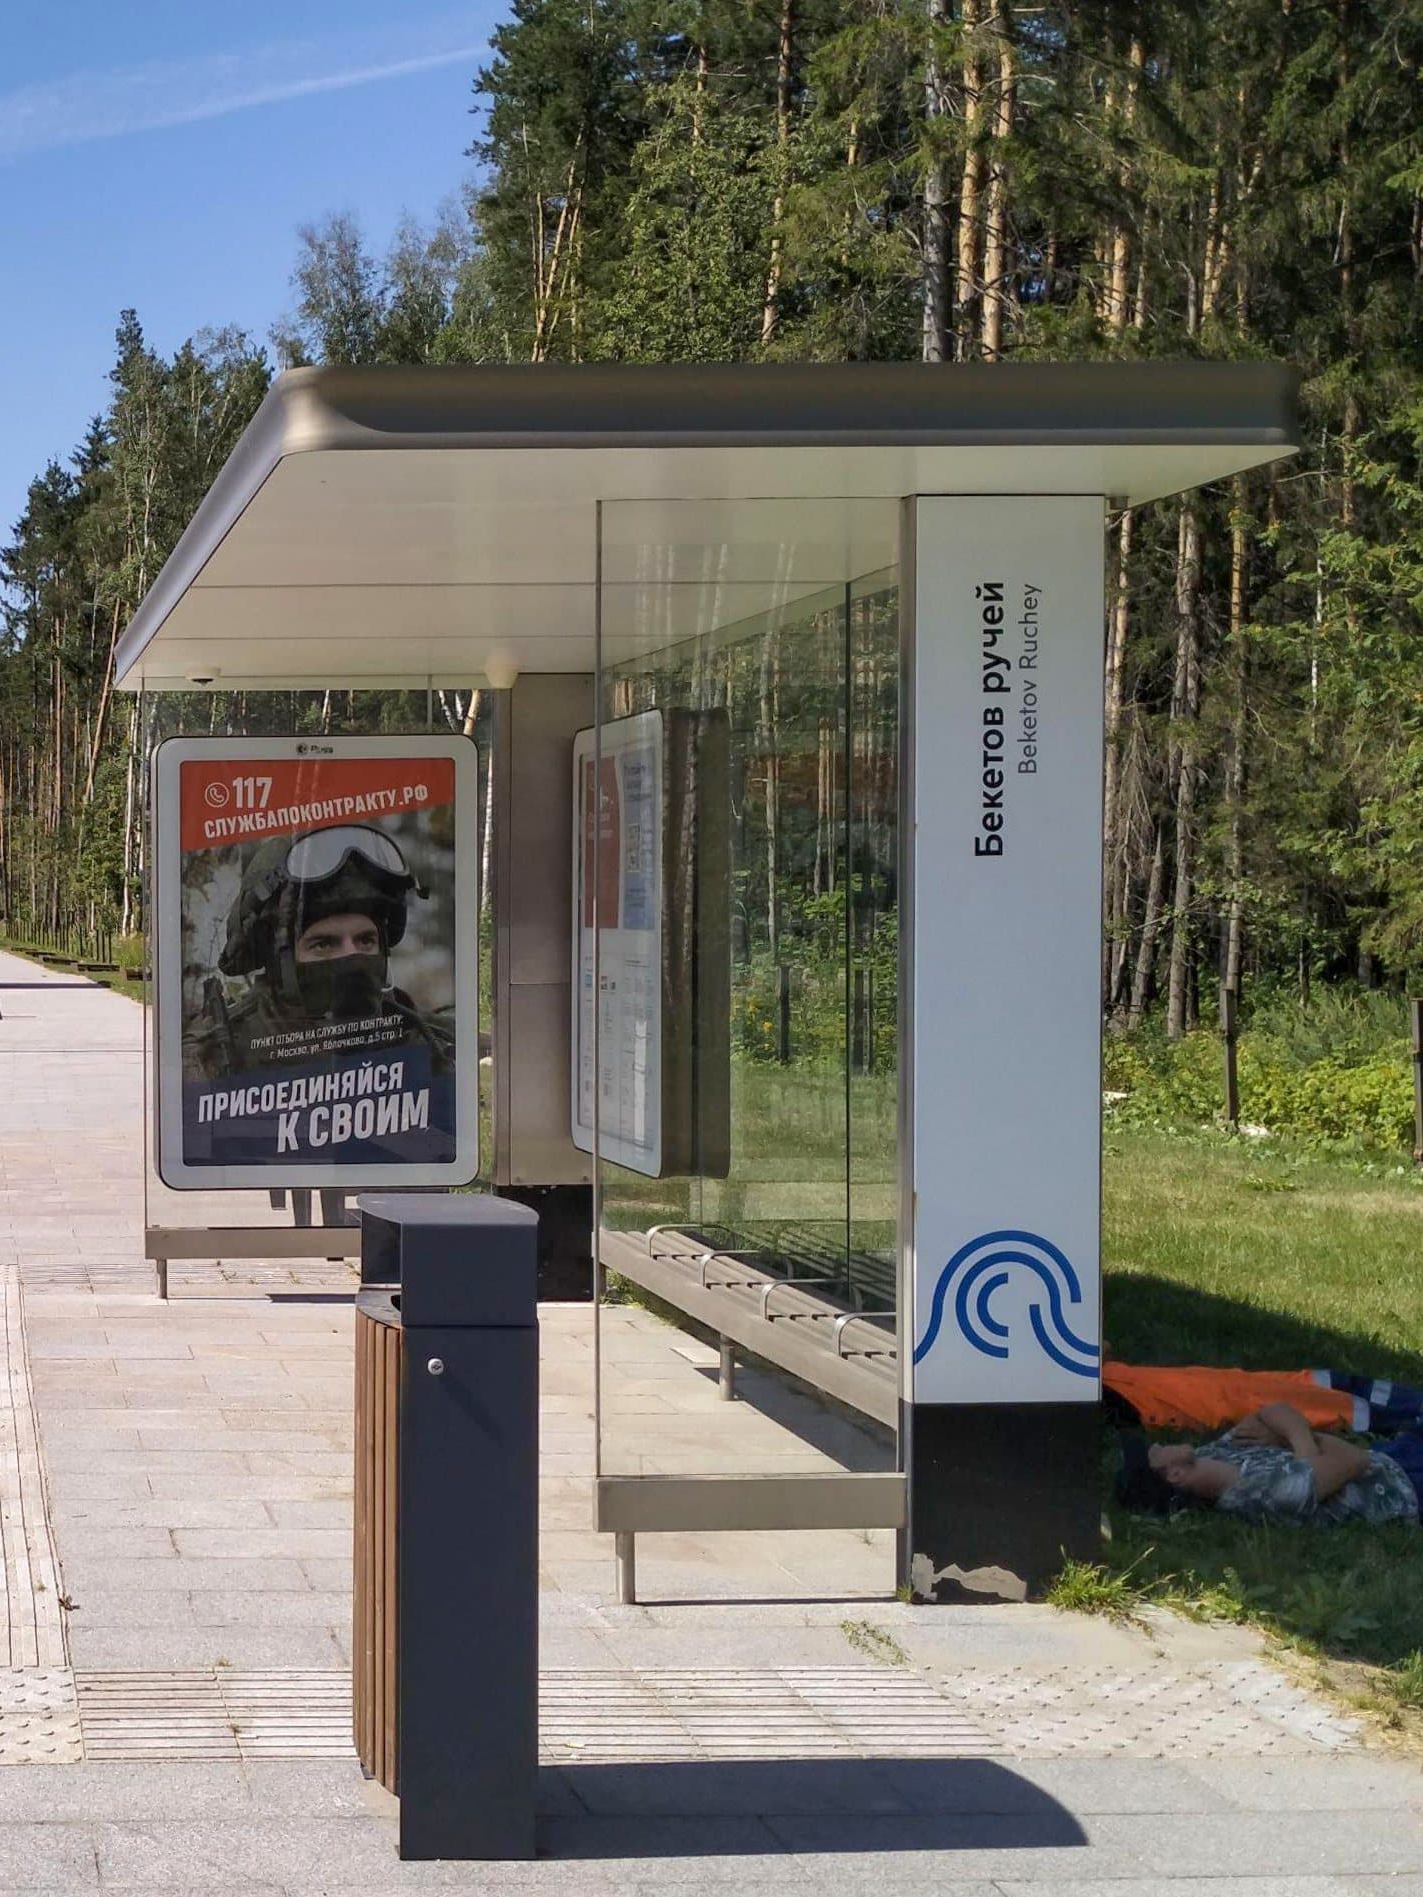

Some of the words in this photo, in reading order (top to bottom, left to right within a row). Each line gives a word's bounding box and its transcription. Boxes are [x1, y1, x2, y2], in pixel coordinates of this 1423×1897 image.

[975, 582, 1011, 693] ручей
[1018, 584, 1042, 669] Ruchey
[1017, 680, 1038, 774] Beketov
[204, 784, 428, 839] СЛУЖБАПОКОНТРАКТУ.РФ
[232, 776, 273, 809] 117
[974, 706, 1004, 857] Бекетов
[250, 1036, 275, 1050] ПУНКТ
[276, 1032, 305, 1045] ОТБОРА
[305, 1029, 316, 1040] НА
[316, 1024, 347, 1038] СЛУЖБУ
[347, 1021, 359, 1033] ПО
[198, 1061, 404, 1123] ПРИСОЕДИНЯЙСЯ
[277, 1111, 300, 1153] К
[308, 1088, 430, 1148] СВОИМ
